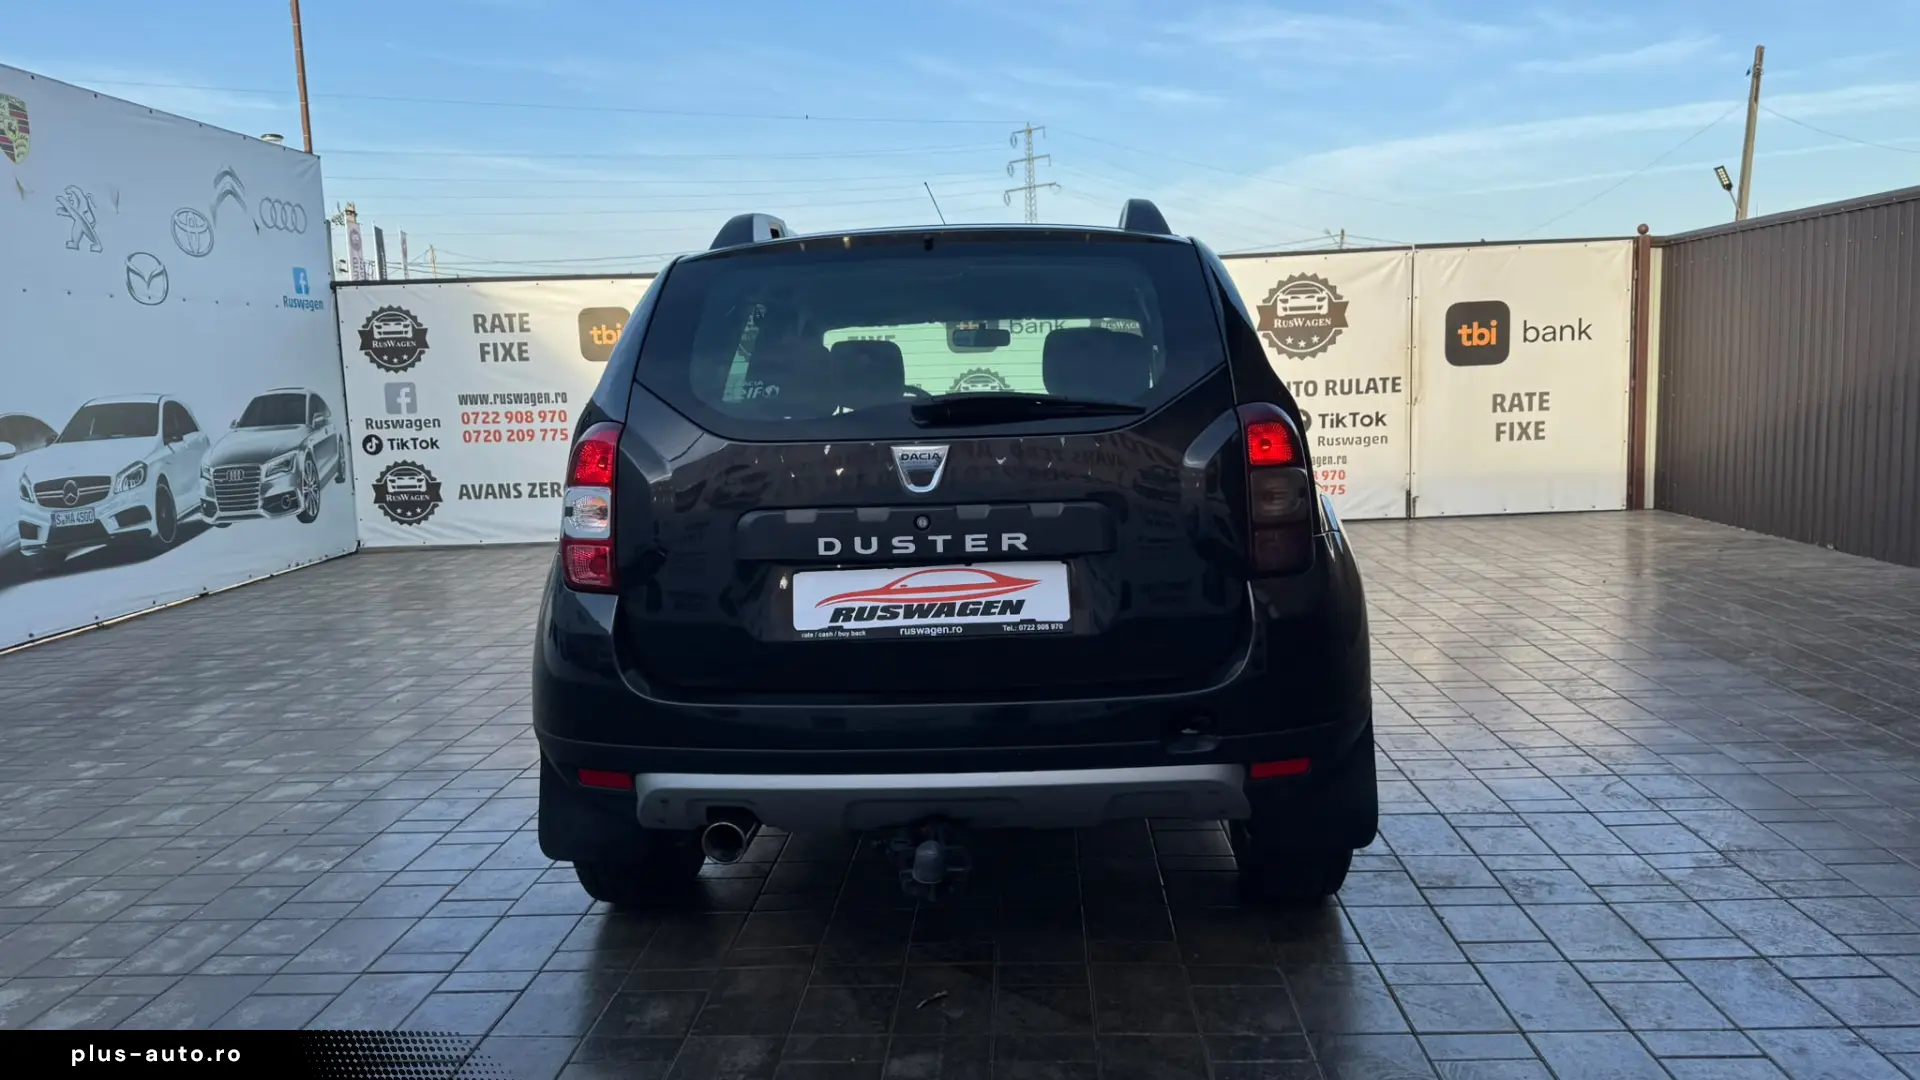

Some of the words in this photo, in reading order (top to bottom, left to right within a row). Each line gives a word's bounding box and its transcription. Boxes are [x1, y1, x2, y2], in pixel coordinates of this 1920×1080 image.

[283, 295, 324, 311] Ruswagen
[473, 312, 531, 334] RATE
[1458, 320, 1497, 346] tbi
[1522, 317, 1593, 343] bank
[589, 323, 622, 345] tbi
[479, 341, 530, 363] FIXE
[1286, 381, 1318, 398] TO
[1325, 376, 1402, 397] RULATE
[458, 392, 568, 407] www.ruswagen.ro
[1491, 391, 1550, 413] RATE
[365, 417, 441, 433] Ruswagen
[461, 411, 500, 425] 0722
[504, 410, 534, 424] 908
[537, 409, 567, 423] 970
[1318, 411, 1388, 429] TikTok
[462, 430, 502, 444] 0720
[506, 429, 536, 443] 209
[539, 428, 569, 442] 775
[1495, 420, 1546, 442] FIXE
[387, 437, 440, 451] TikTok
[1317, 435, 1389, 448] Ruswagen
[901, 452, 941, 461] DACIA
[1321, 470, 1346, 481] 970
[458, 482, 522, 501] AVANS
[528, 481, 565, 499] ZER
[818, 533, 1029, 556] DUSTER
[829, 599, 1026, 624] RUSWAGEN
[818, 630, 834, 638] cash
[838, 630, 850, 638] buy
[900, 625, 963, 637] ruswagen.ro
